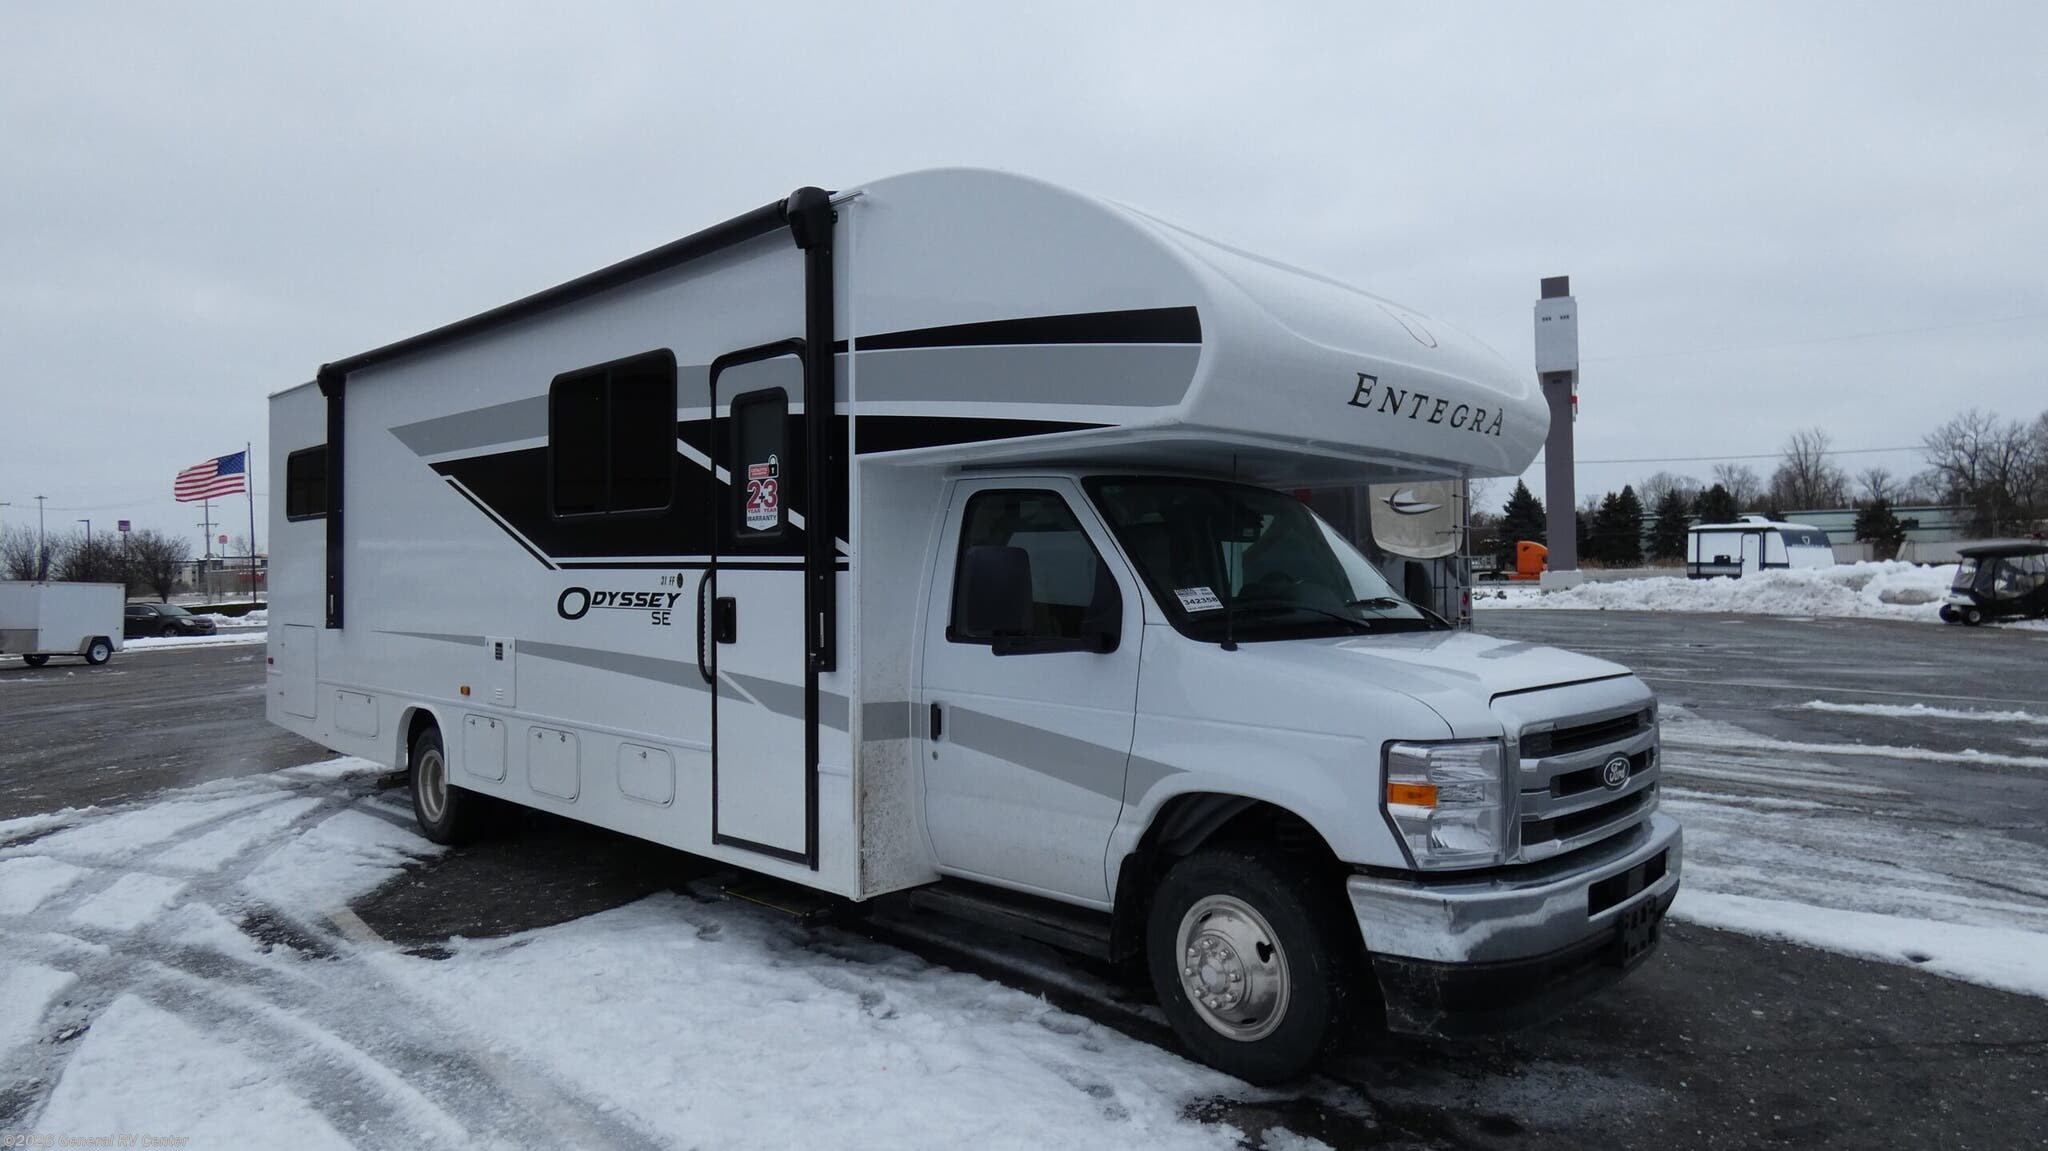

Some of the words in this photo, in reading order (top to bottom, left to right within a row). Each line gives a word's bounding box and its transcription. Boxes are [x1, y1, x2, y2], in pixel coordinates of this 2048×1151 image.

[557, 587, 681, 620] ODYSSEY
[651, 611, 672, 626] SE
[1609, 761, 1626, 782] Ford
